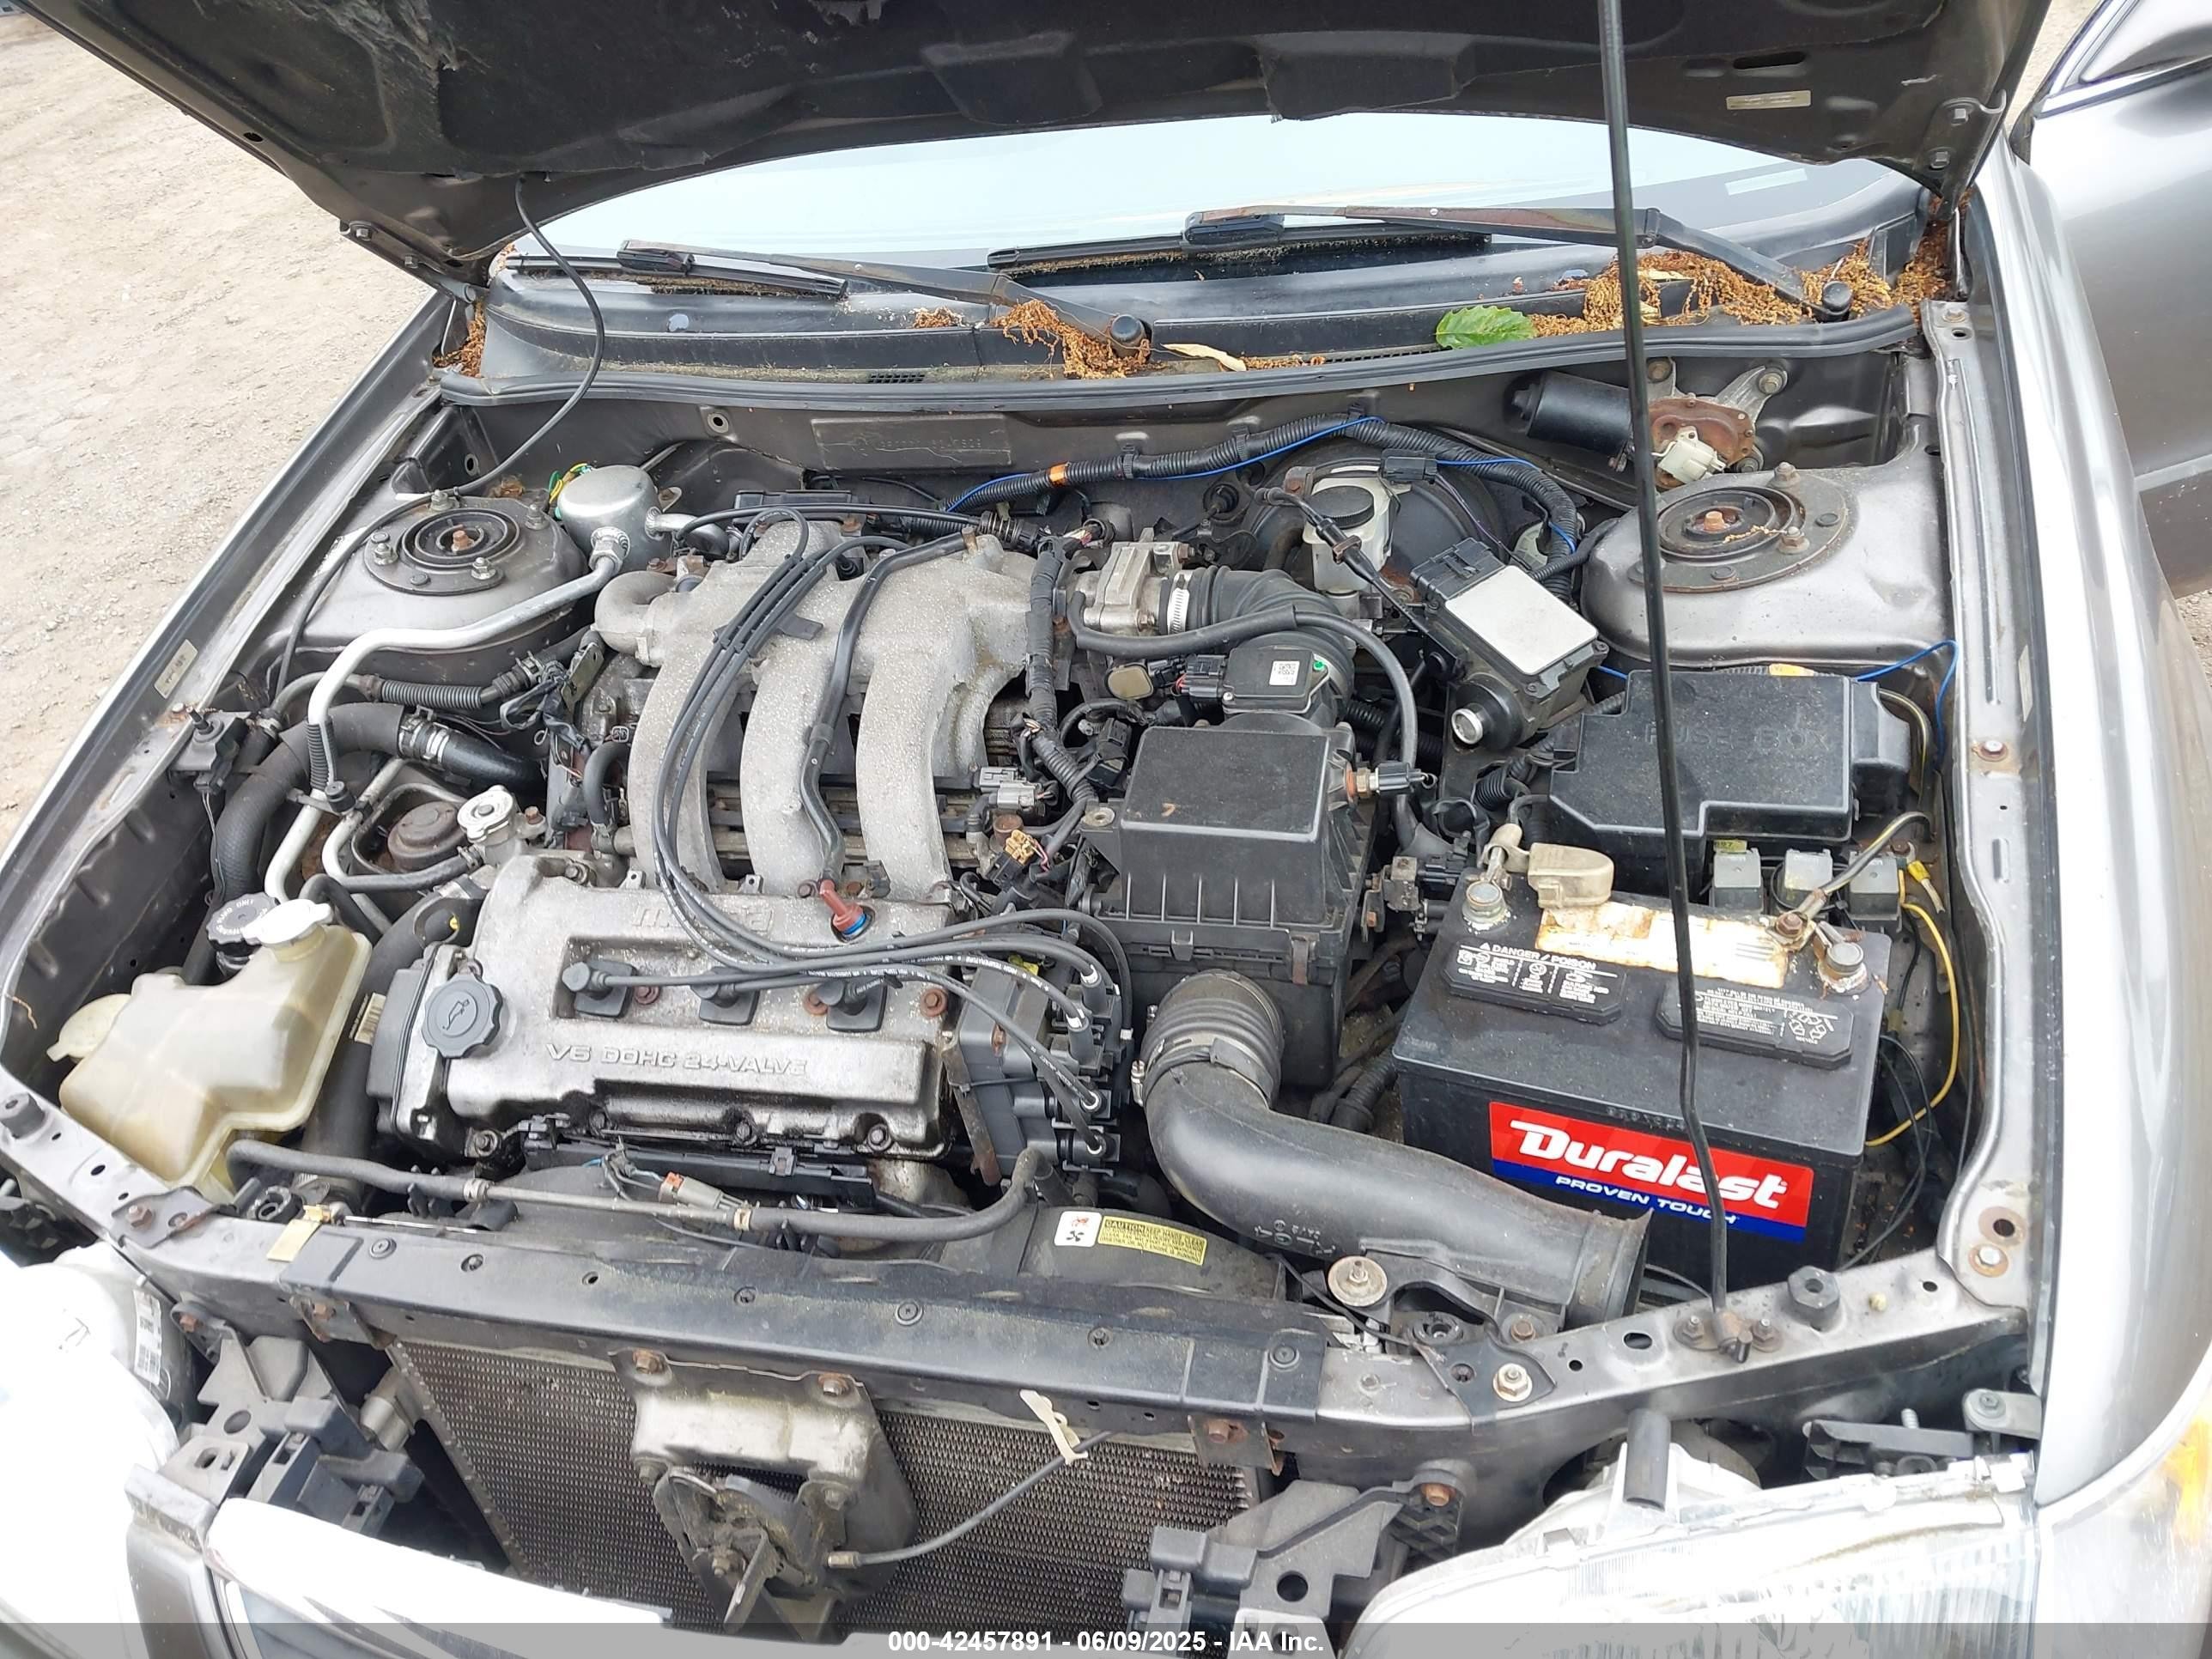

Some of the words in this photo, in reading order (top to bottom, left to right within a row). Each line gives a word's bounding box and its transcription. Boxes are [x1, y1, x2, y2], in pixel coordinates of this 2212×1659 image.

[1492, 944, 1541, 960] DANGER
[1550, 955, 1597, 971] POISON
[546, 1042, 592, 1063] V6
[600, 1046, 678, 1069] DOHC
[684, 1053, 807, 1076] 24-VALVE
[1510, 1119, 1787, 1210] Duralast
[1555, 1174, 1650, 1206] PROVEN
[1105, 1219, 1146, 1235] CAUTION
